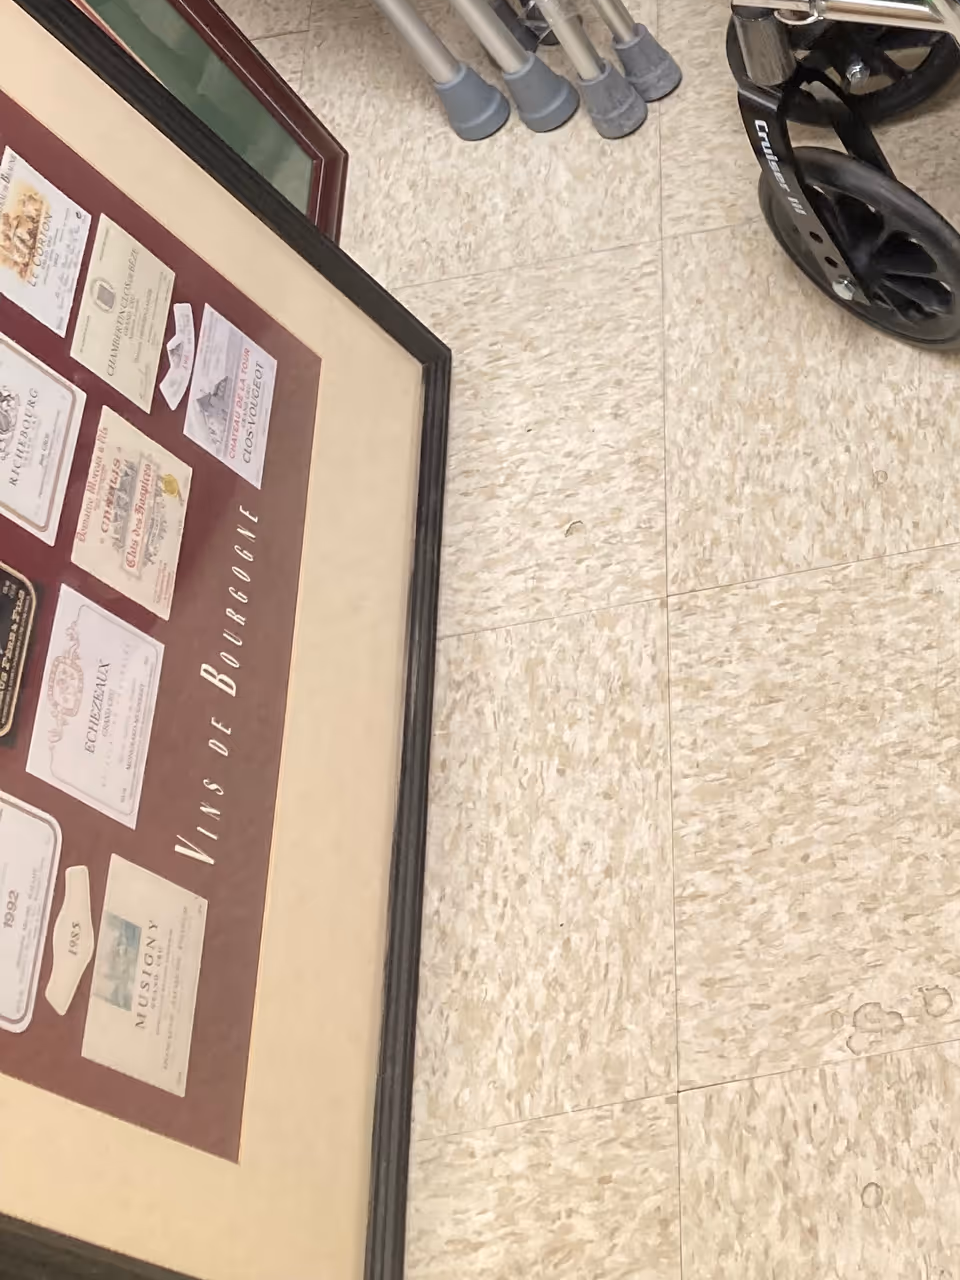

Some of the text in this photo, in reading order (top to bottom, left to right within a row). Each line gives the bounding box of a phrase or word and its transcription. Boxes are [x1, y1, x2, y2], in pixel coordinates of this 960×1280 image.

[754, 119, 790, 192] Cruiser
[32, 213, 53, 267] CORTON
[106, 310, 125, 377] CHAMBERTIN
[241, 347, 251, 375] TOUR
[235, 393, 244, 409] DE
[239, 377, 248, 392] LA
[9, 387, 39, 487] RICHEBOURG
[242, 360, 265, 464] CLOS-VOUGEOT
[134, 463, 152, 517] Hospices
[131, 513, 143, 538] des
[12, 589, 25, 623] FILS
[200, 504, 259, 697] BOURGOGNE
[84, 659, 111, 755] ECHEZEAUX
[208, 716, 233, 757] DE
[174, 777, 224, 865] VINS
[4, 889, 19, 929] 1992
[68, 921, 82, 957] 1985
[135, 919, 159, 1030] MUSIGNY
